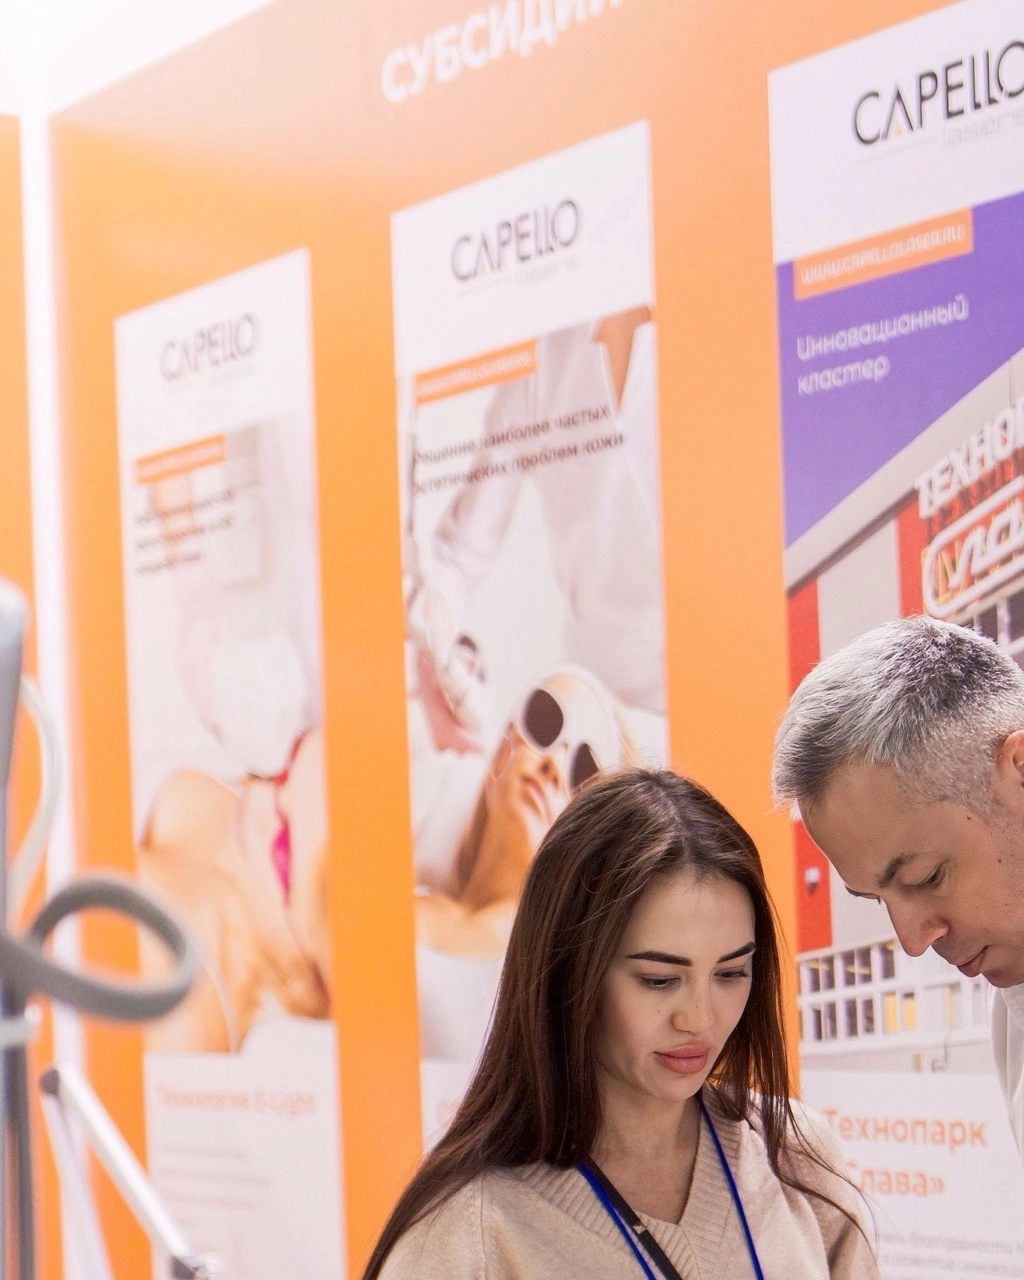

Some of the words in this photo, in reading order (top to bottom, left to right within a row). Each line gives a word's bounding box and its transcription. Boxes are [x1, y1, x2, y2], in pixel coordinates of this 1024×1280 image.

[382, 0, 622, 102] СУБСИД
[450, 199, 580, 283] CAPELLO
[159, 313, 257, 382] CAPELLO
[796, 293, 970, 361] Инновационный
[797, 355, 891, 396] кластер
[554, 404, 610, 431] частых
[511, 442, 579, 476] проблем
[584, 432, 624, 456] кожи
[823, 1107, 988, 1153] Технопарк
[846, 1160, 945, 1197] лава»
